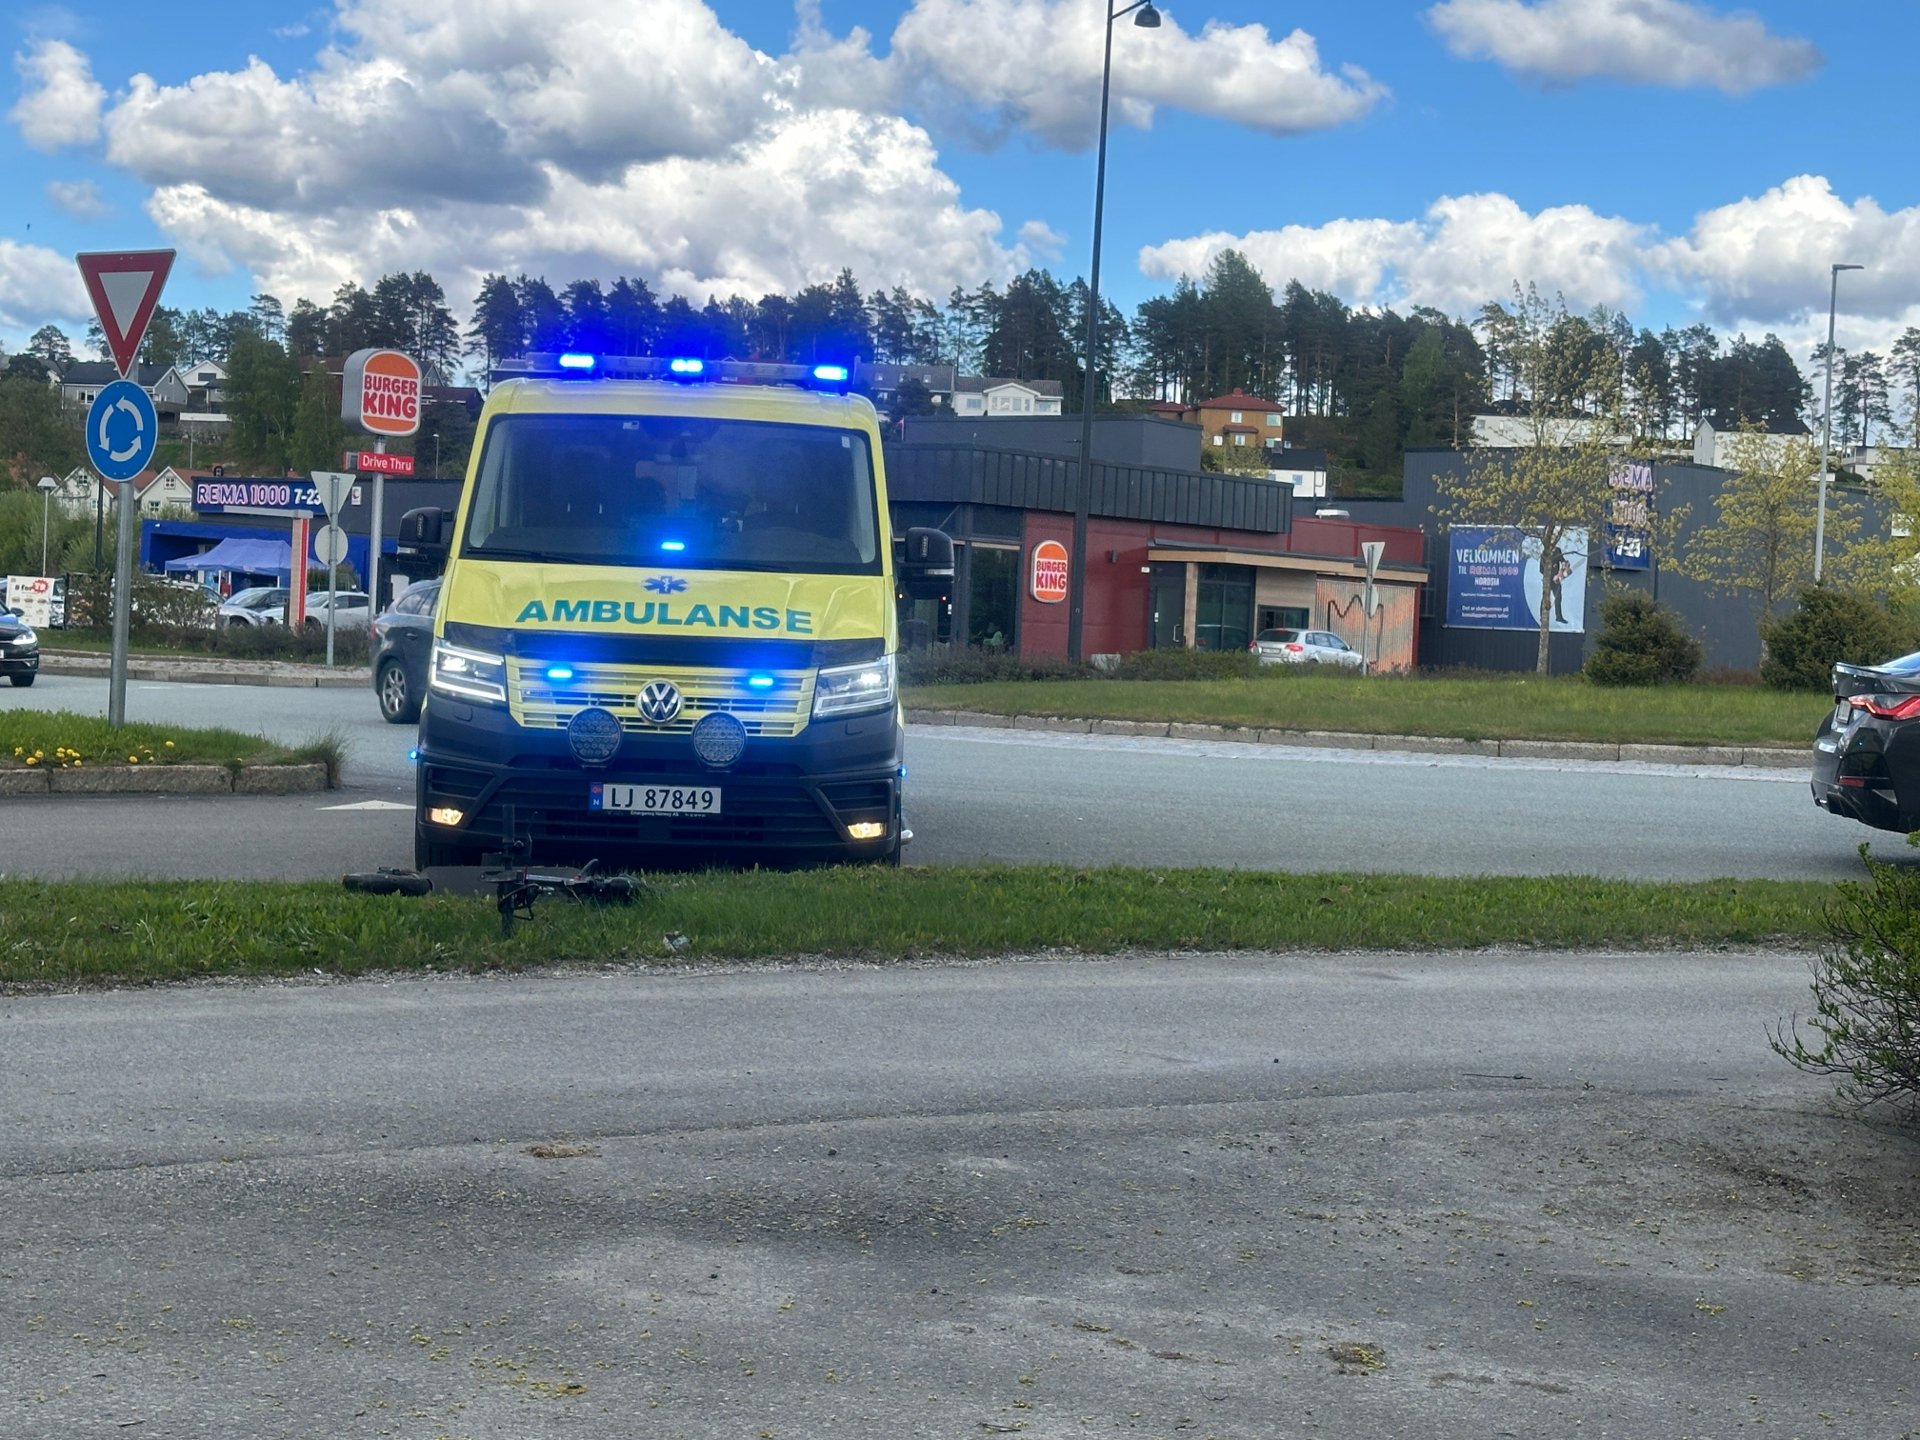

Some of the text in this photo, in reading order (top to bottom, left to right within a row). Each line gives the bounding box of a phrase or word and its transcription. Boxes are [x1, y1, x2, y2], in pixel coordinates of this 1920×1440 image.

[364, 375, 418, 396] BURGER
[363, 391, 417, 419] KING
[362, 455, 412, 471] Drive Thru
[197, 483, 248, 505] REMA
[250, 484, 290, 506] 1000
[1456, 549, 1519, 564] VELKOMMEN
[1036, 560, 1067, 573] BURGER
[1458, 565, 1467, 575] TIL
[1036, 572, 1066, 590] KING
[515, 600, 813, 634] AMBULANSE
[611, 788, 634, 808] LJ
[644, 789, 714, 810] 87849
